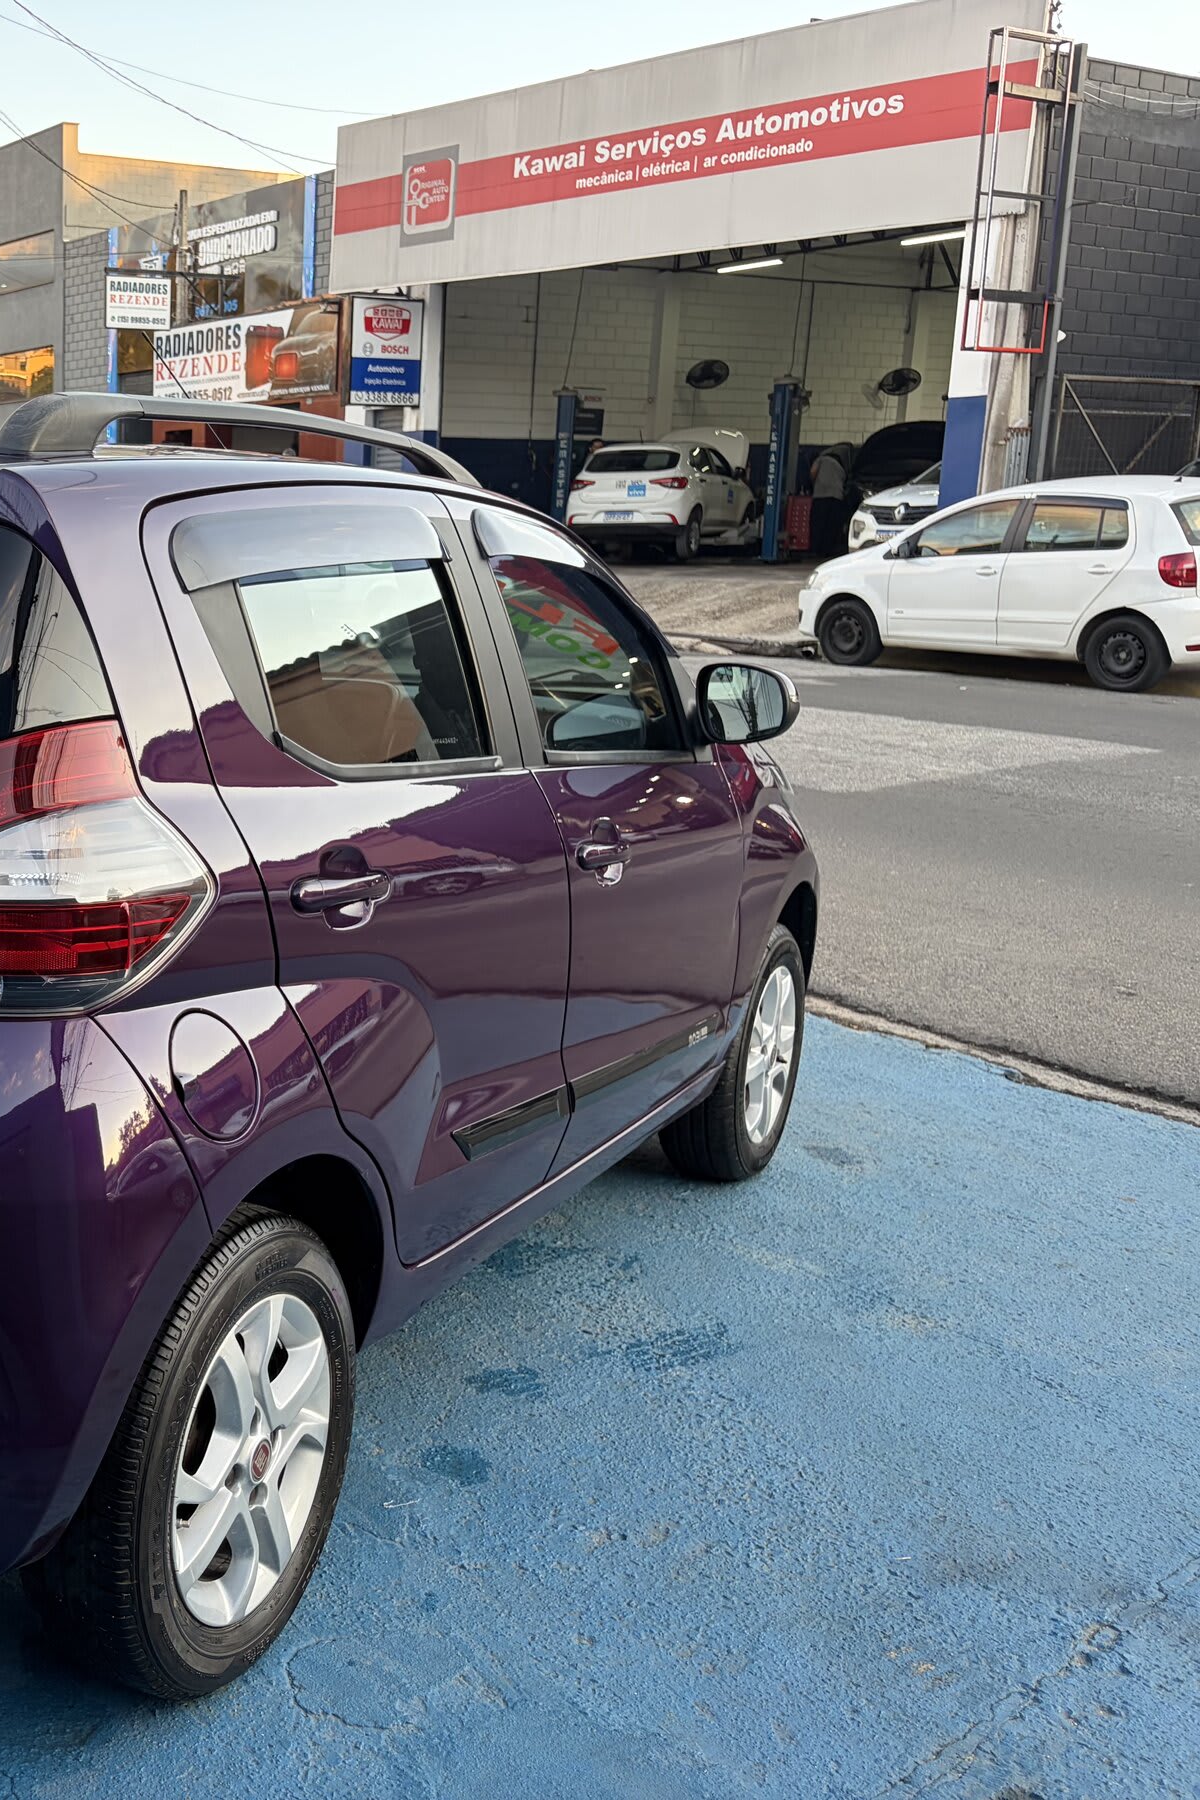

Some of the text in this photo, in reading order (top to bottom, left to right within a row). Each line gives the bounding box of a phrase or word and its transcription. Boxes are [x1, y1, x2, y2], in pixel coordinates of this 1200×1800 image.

[513, 94, 905, 179] Kawai Serviços Automotivos
[575, 138, 814, 189] mecânica elétrica ar condicionado
[432, 185, 449, 194] AUTO
[198, 226, 278, 267] ONDICIONADO
[110, 281, 168, 295] RADIADORES
[110, 294, 169, 307] REZENDE
[372, 318, 403, 330] KAWAI
[155, 323, 242, 360] RADIADORES
[381, 345, 409, 354] BOSCH
[155, 351, 241, 382] REZENDE
[367, 364, 405, 374] Automotivo
